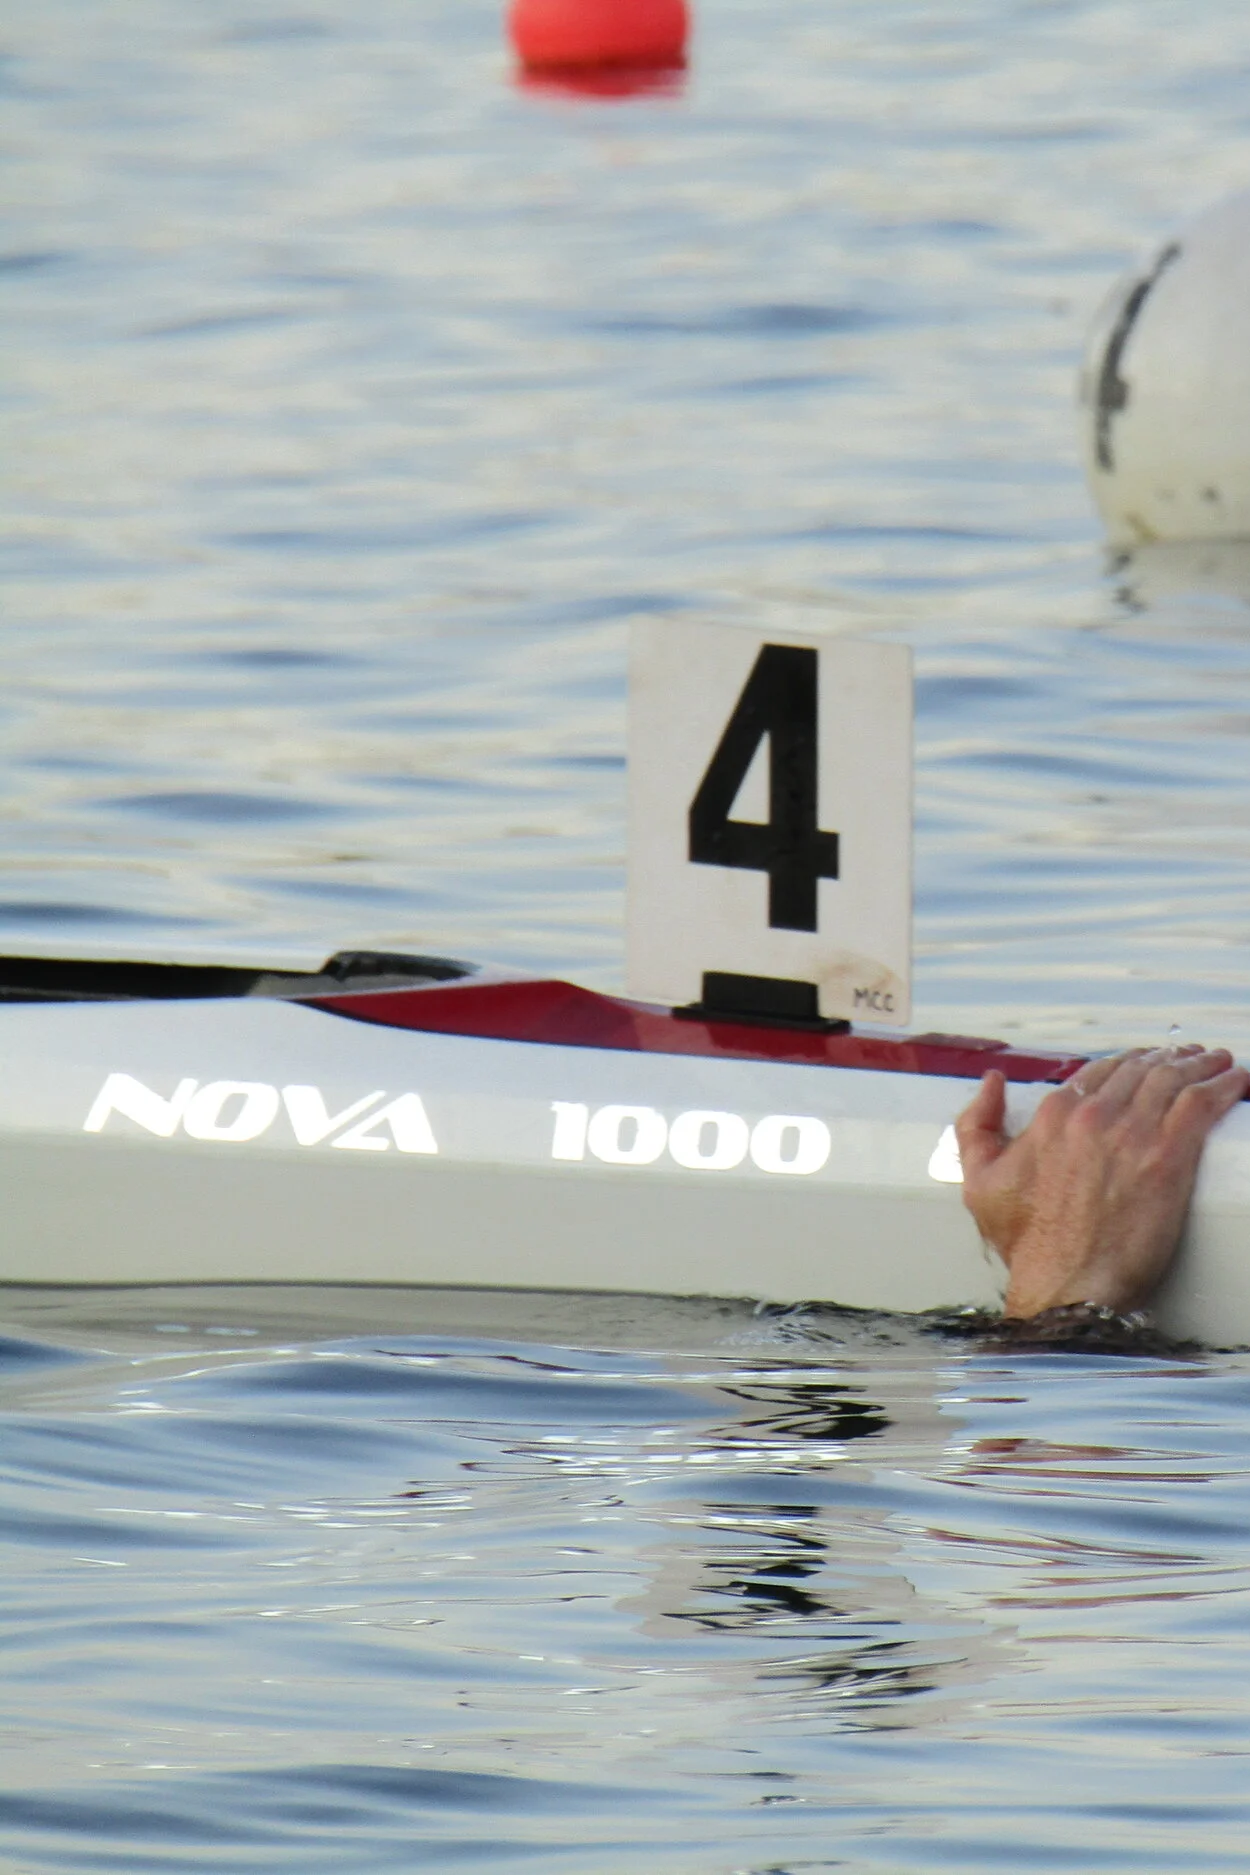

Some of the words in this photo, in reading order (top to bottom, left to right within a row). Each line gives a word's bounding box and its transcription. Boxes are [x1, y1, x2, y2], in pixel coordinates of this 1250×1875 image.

[689, 643, 839, 933] 4
[853, 987, 895, 1013] MCC
[83, 1072, 439, 1154] NOVA
[551, 1101, 831, 1176] 1000
